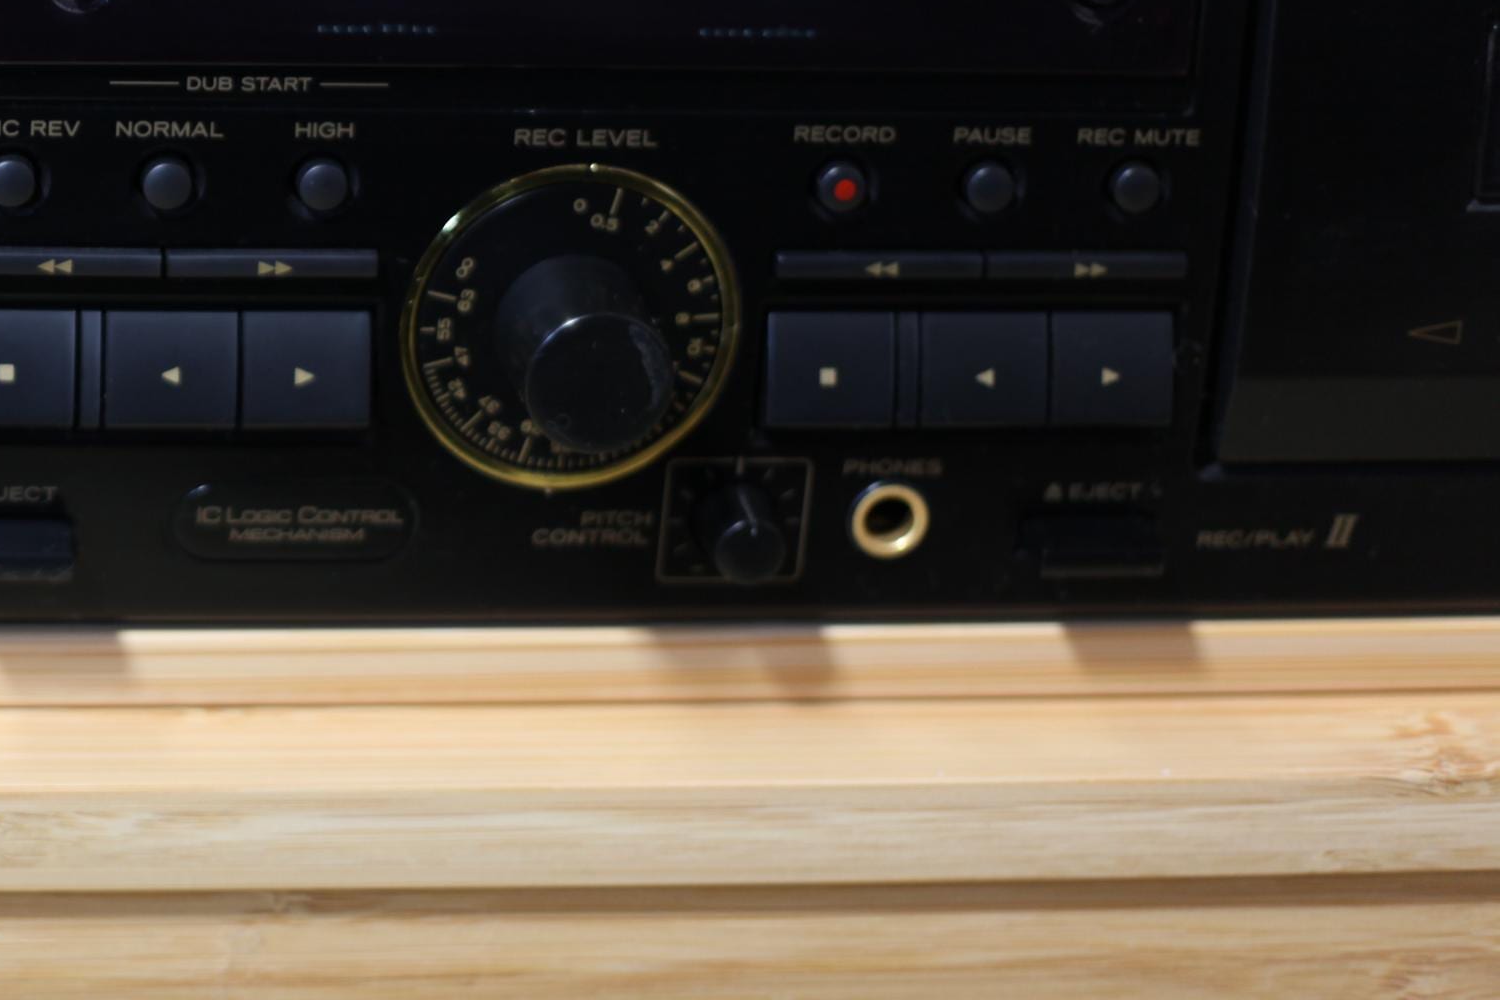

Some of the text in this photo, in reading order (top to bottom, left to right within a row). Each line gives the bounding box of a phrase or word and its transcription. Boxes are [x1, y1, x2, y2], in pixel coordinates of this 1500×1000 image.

[186, 76, 312, 93] DUB START
[30, 120, 81, 138] REV
[114, 121, 224, 139] NORMAL
[294, 122, 355, 139] HIGH
[513, 128, 658, 147] REC LEVEL
[793, 125, 897, 144] RECORD
[952, 126, 1032, 145] PAUSE
[1077, 127, 1201, 147] REC MUTE
[841, 457, 946, 477] PHONES
[1067, 480, 1143, 500] EJECT
[580, 510, 654, 527] PITCH
[228, 527, 367, 543] MECHANISM
[530, 529, 649, 547] CONTROL
[1196, 528, 1316, 549] REC/PLAY
